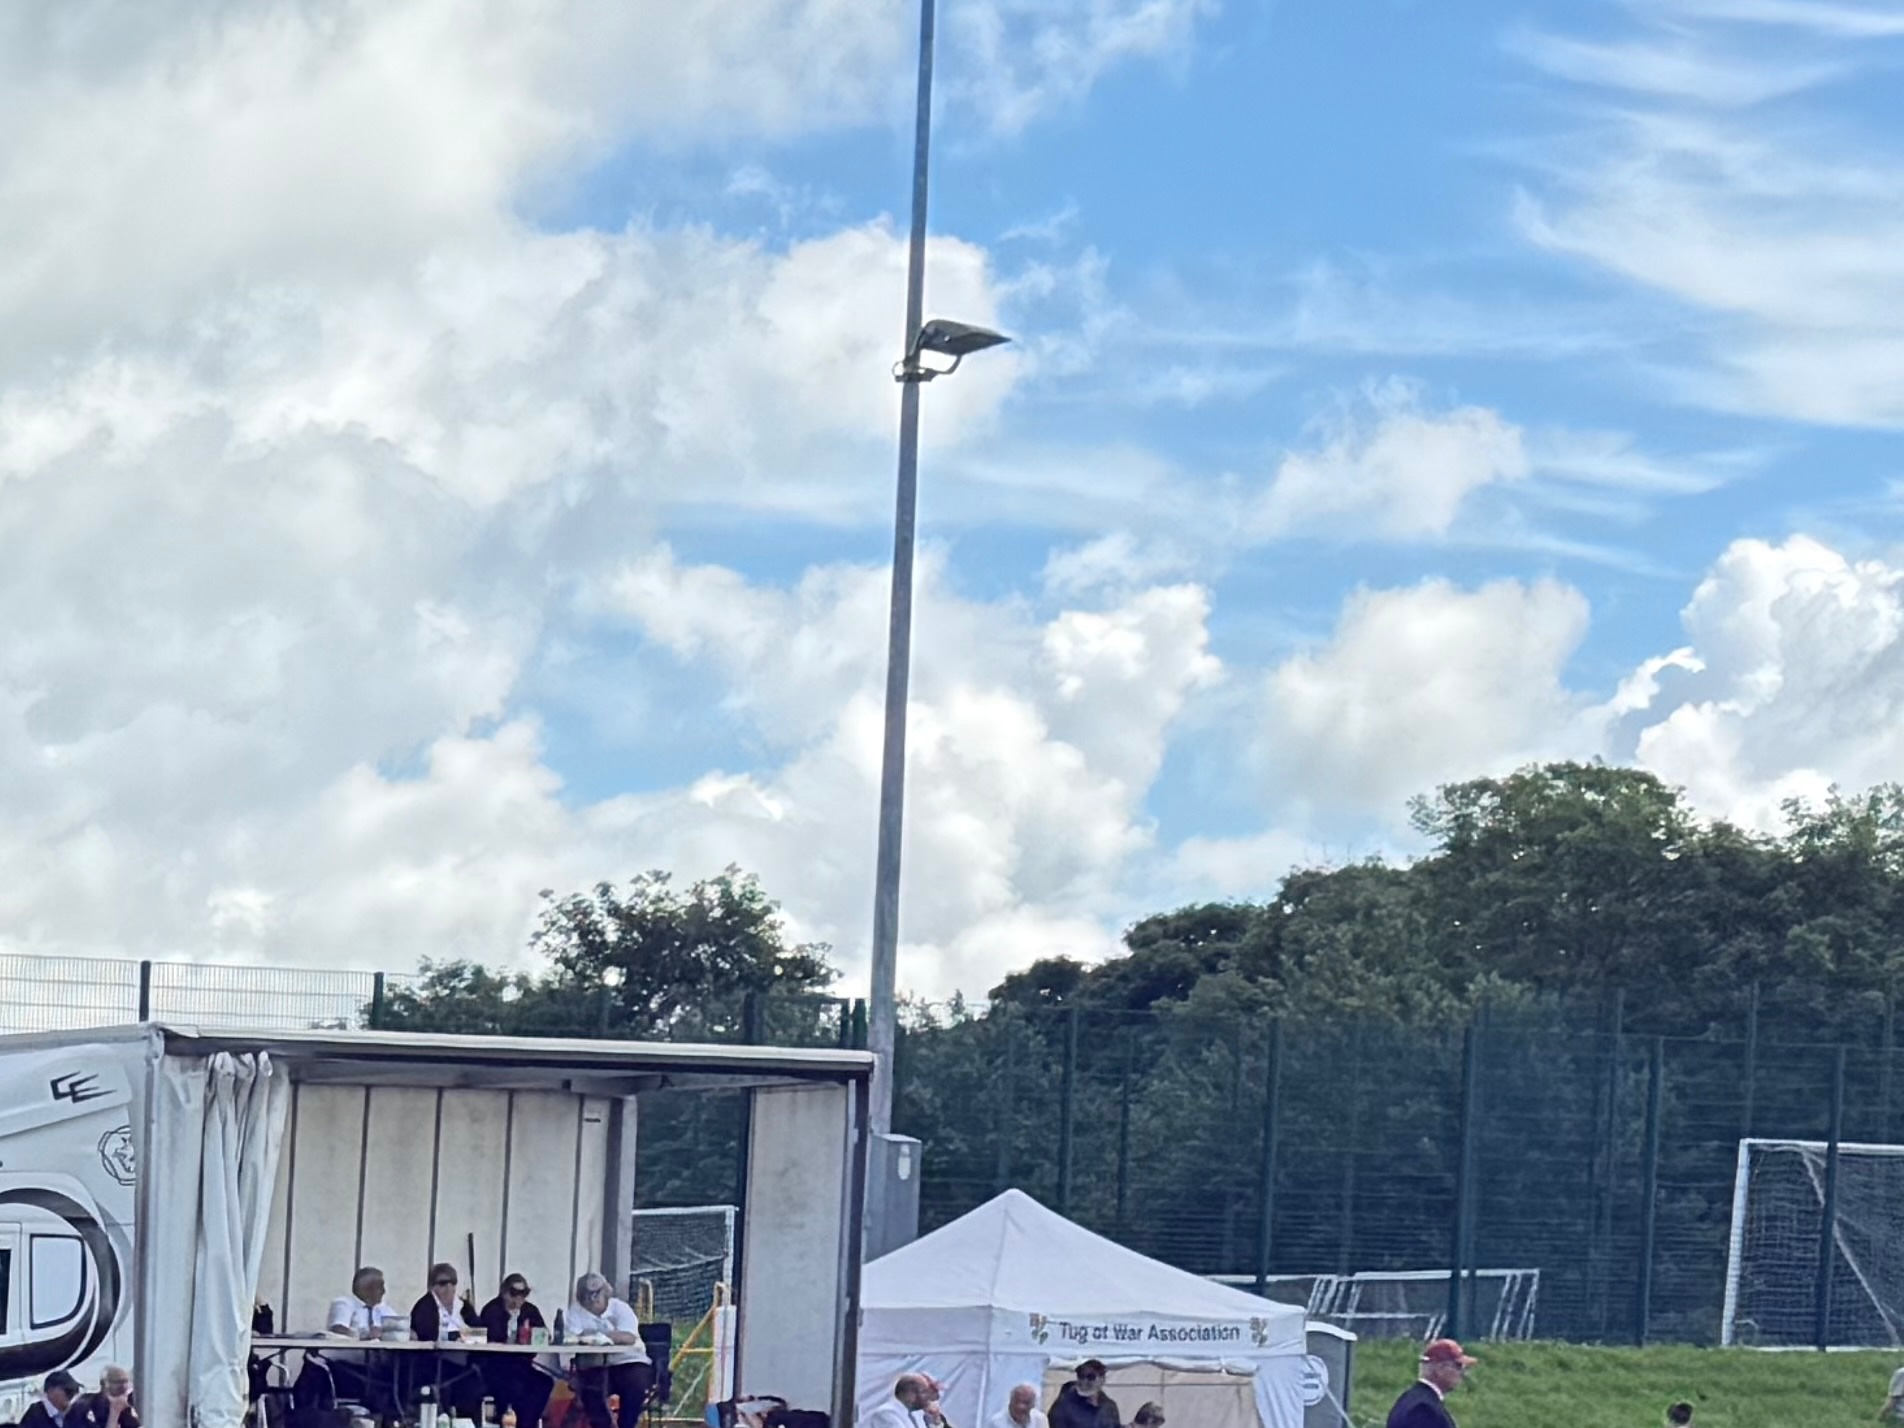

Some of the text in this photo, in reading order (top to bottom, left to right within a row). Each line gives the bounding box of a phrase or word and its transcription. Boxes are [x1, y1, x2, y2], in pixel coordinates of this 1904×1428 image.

[1058, 1322, 1241, 1344] Tug of War Association
